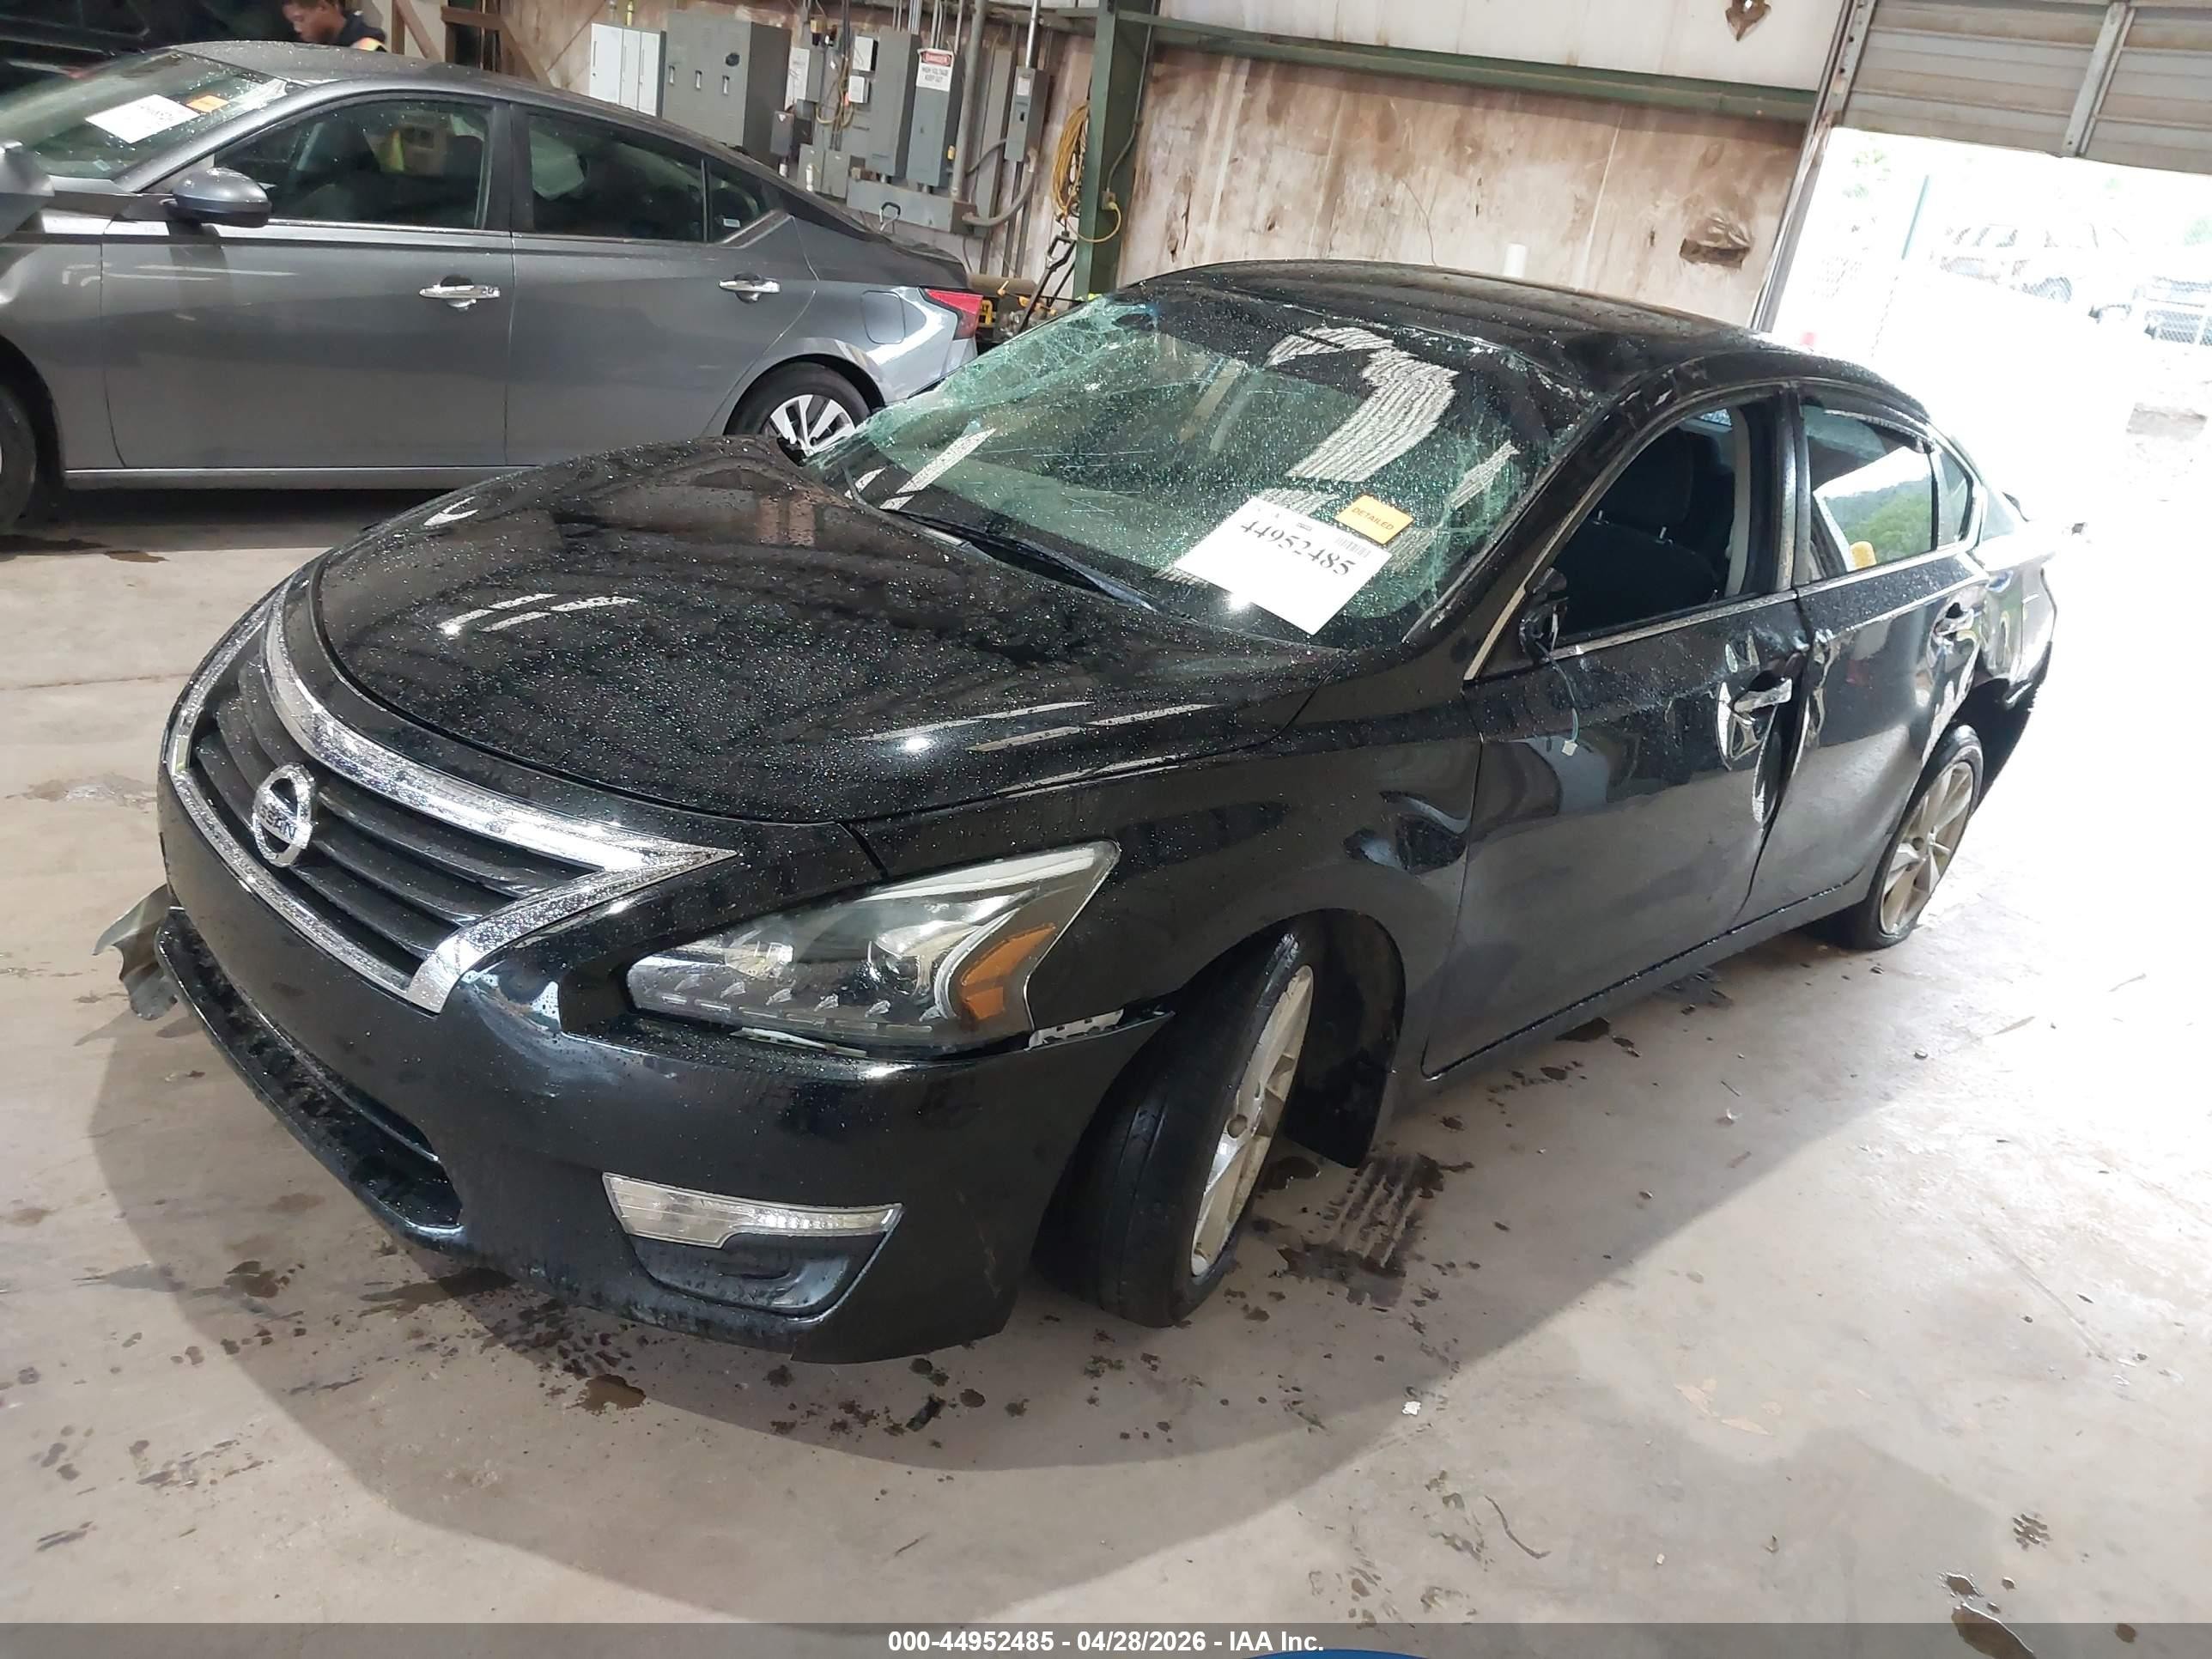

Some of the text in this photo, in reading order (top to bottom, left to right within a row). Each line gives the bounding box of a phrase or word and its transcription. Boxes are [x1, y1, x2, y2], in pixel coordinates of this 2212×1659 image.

[1352, 507, 1395, 531] DETAILED
[1240, 520, 1357, 575] 44952485
[258, 803, 297, 840] SSAN
